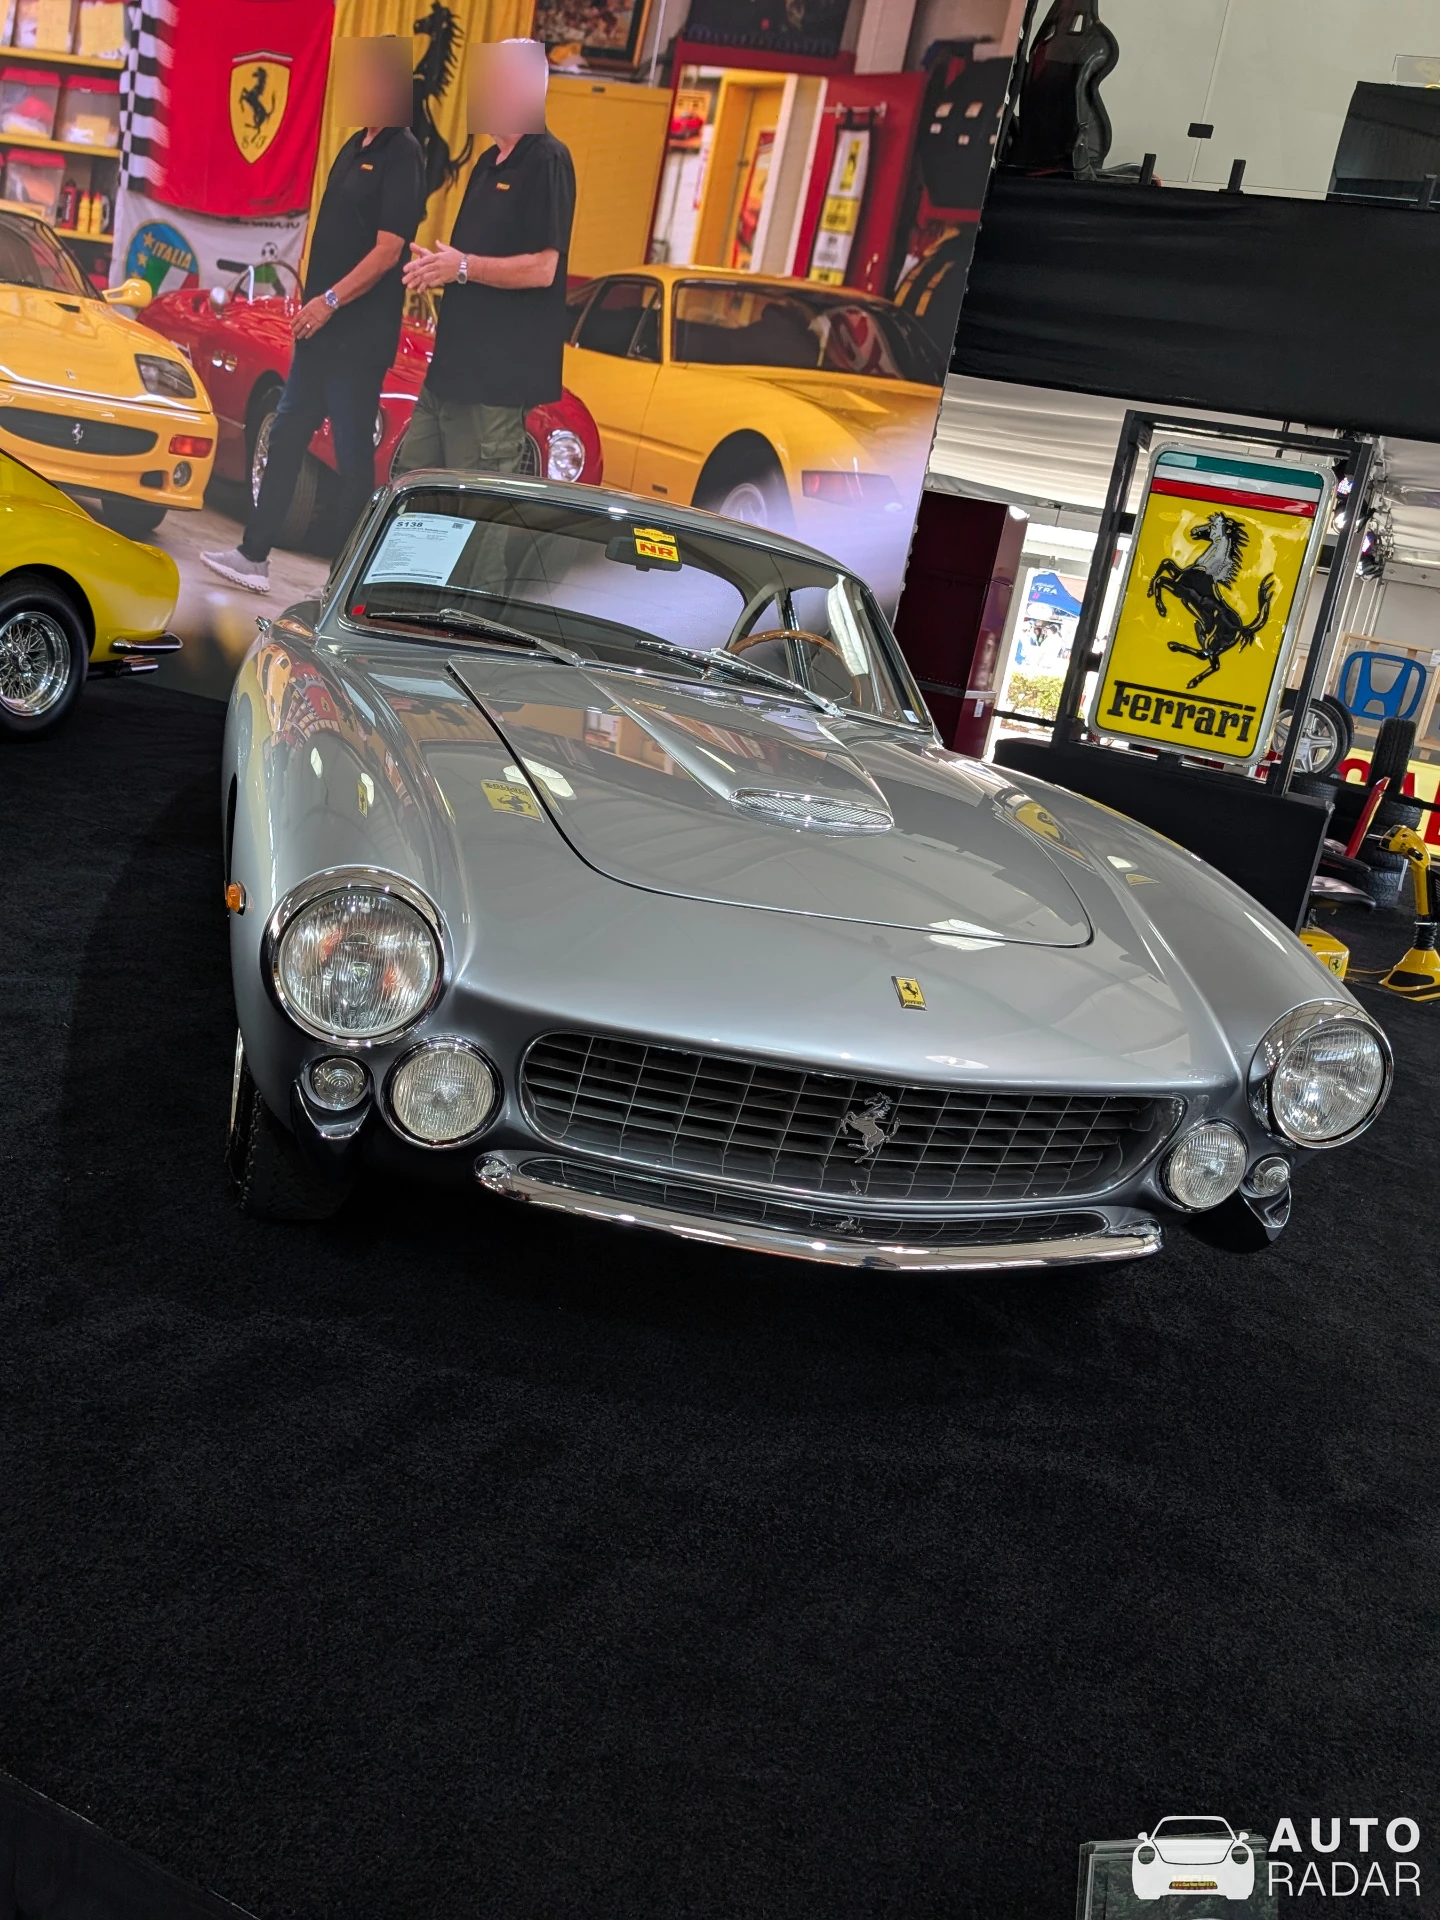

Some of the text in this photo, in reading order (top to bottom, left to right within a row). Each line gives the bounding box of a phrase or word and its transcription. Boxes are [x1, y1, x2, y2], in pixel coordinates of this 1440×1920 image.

[151, 241, 192, 269] ITALIA
[639, 543, 674, 557] NR
[1031, 585, 1058, 596] LTRA
[1106, 680, 1257, 742] Ferrari
